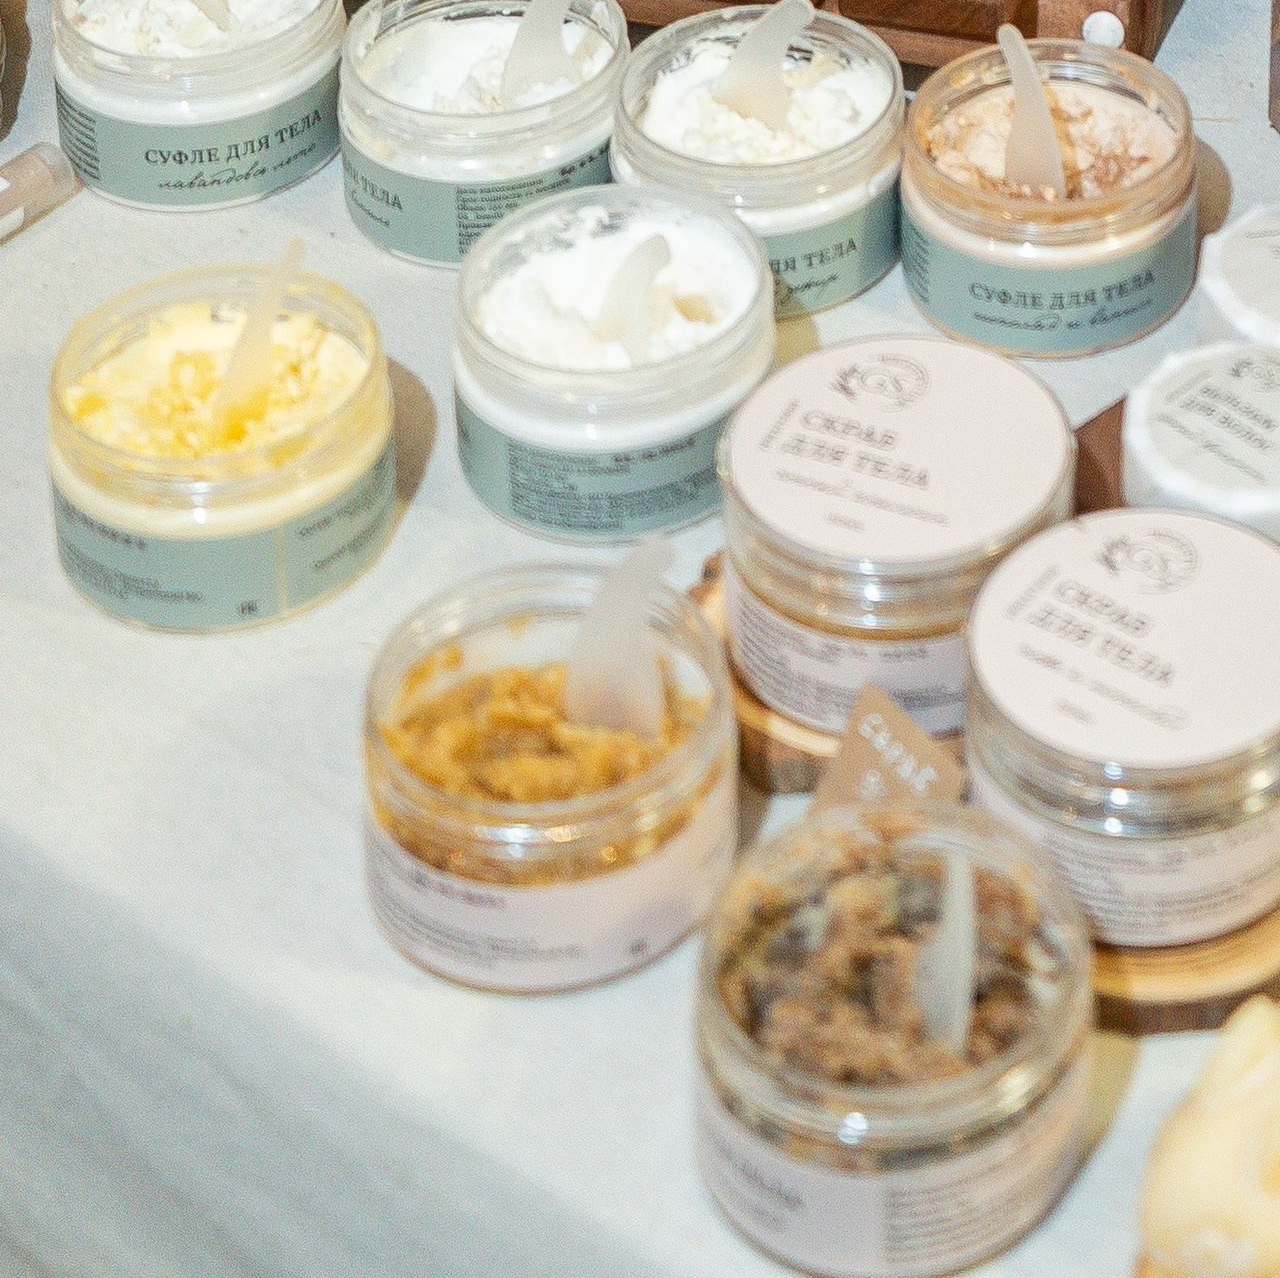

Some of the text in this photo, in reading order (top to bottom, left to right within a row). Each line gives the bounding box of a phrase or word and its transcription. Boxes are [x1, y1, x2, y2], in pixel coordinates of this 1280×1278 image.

[144, 109, 323, 166] СУФЛЕ ДЛЯ ТЕЛА
[361, 174, 403, 210] ТЕЛА
[804, 237, 858, 266] ТЕЛА
[968, 270, 1154, 311] СУФЛЕ ДЛЯ ТЕЛА
